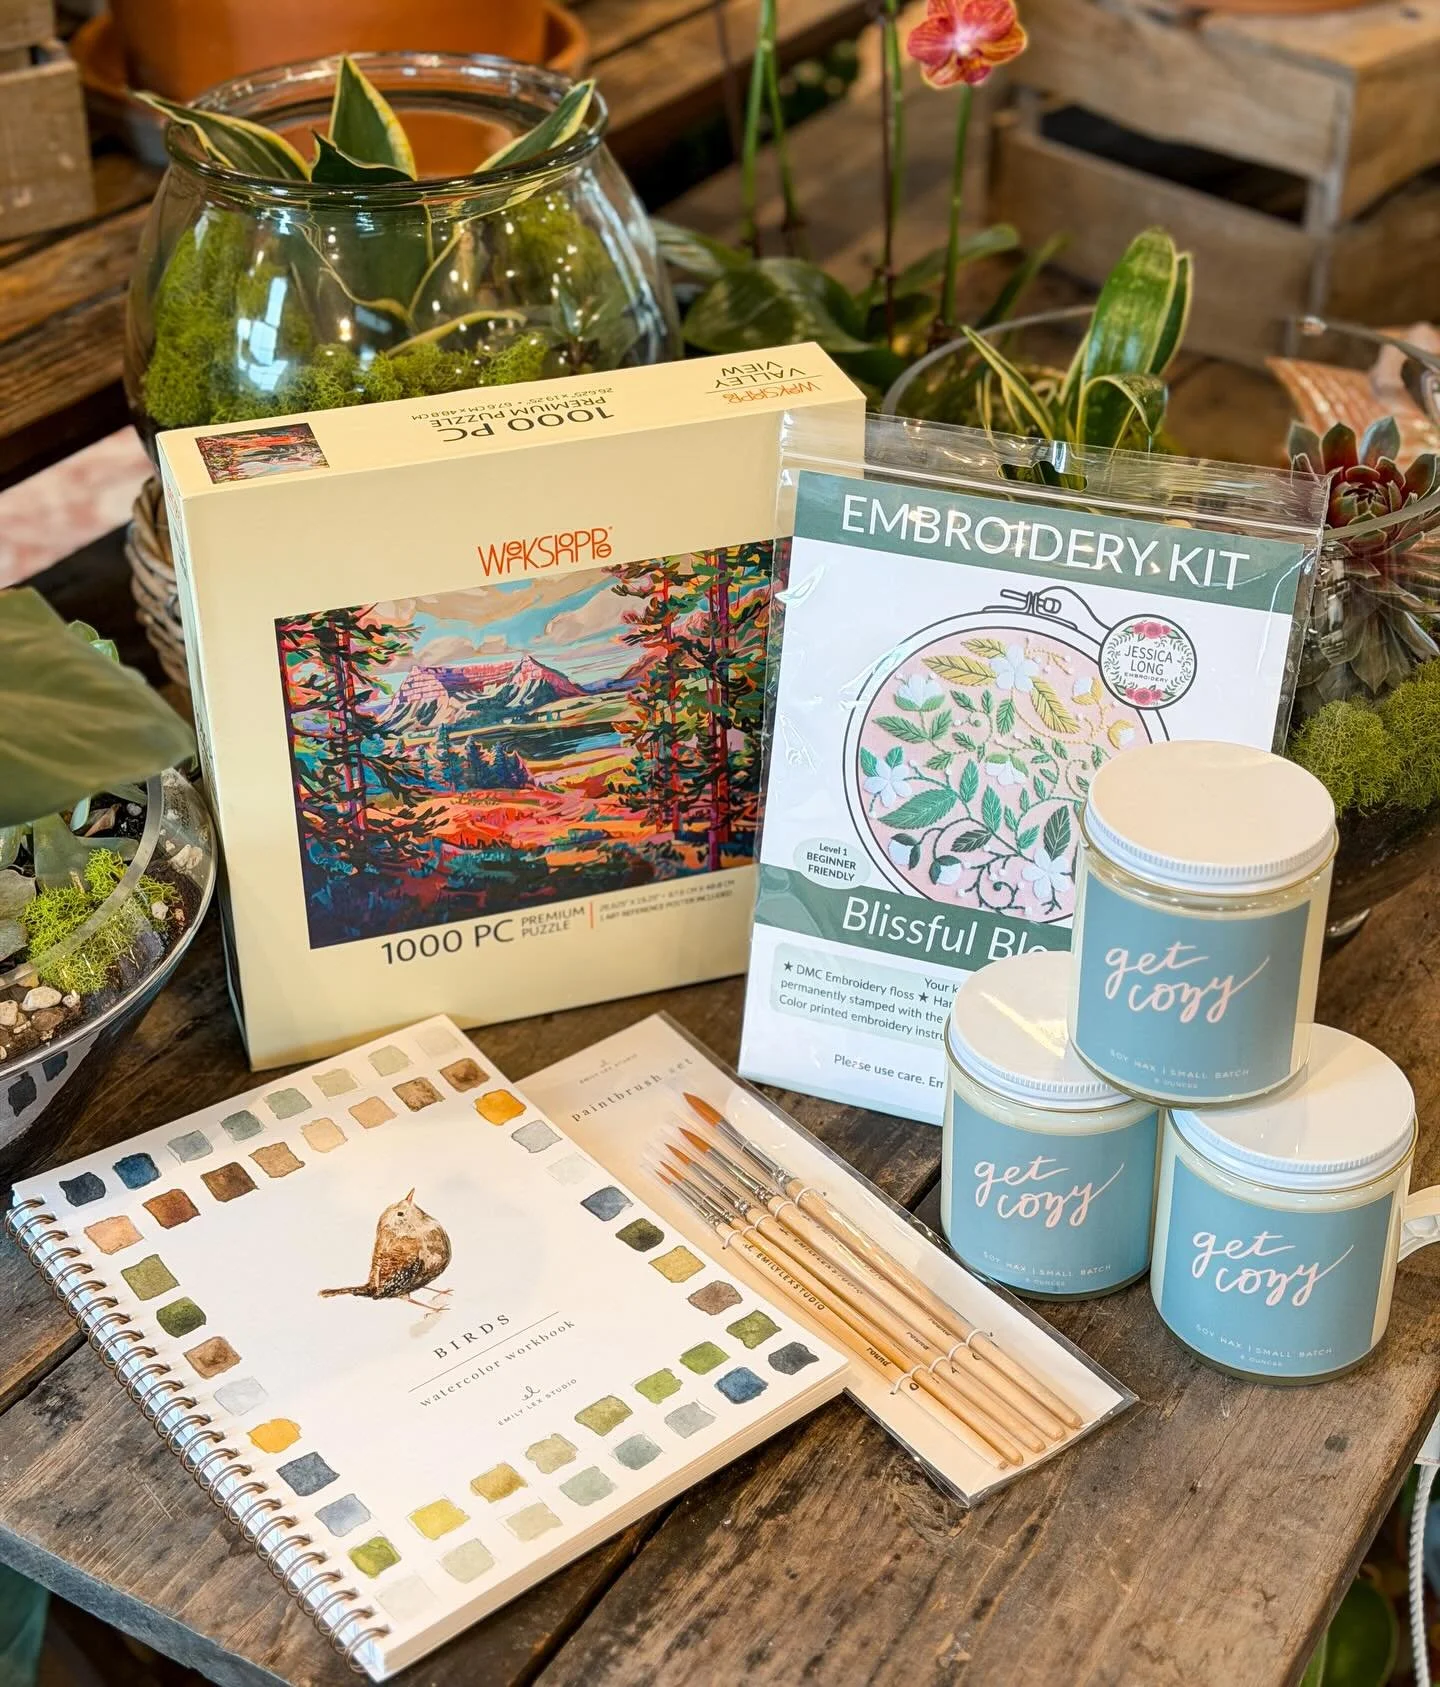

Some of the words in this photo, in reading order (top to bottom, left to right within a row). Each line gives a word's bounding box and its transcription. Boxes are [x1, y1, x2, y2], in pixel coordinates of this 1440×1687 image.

[715, 367, 806, 388] VALLEY
[721, 361, 783, 376] VIEW
[510, 396, 607, 416] PREMIUM
[411, 413, 429, 421] CM
[430, 410, 505, 428] PUZZLE
[507, 406, 615, 432] 1000
[436, 422, 495, 442] PC
[841, 493, 1159, 577] EMBROIDERY
[1168, 543, 1250, 591] KIT
[1124, 645, 1173, 664] JESSICA
[1124, 672, 1168, 683] EMBROIDERY
[1130, 659, 1164, 676] LONG
[819, 842, 841, 854] Level
[842, 848, 848, 856] 1
[806, 851, 856, 870] BEGINNER
[808, 864, 855, 882] FRIENDLY
[520, 906, 585, 927] PREMIUM
[842, 896, 978, 956] Blissful
[521, 919, 571, 938] PUZZLE
[381, 930, 463, 965] 1000
[474, 919, 514, 947] PC
[1104, 940, 1210, 1000] get
[796, 964, 824, 980] DMC
[825, 971, 887, 996] Embroidery
[889, 986, 915, 1001] floss
[924, 977, 950, 993] Your
[1128, 955, 1270, 1024] cozy
[780, 978, 847, 1004] permanently
[849, 994, 896, 1014] stamped
[898, 1003, 922, 1020] with
[925, 1010, 943, 1024] the
[779, 994, 807, 1010] Color
[809, 1001, 848, 1020] printed
[851, 1011, 912, 1036] embroidery
[834, 1053, 871, 1073] Please
[874, 1065, 894, 1078] use
[897, 1070, 925, 1086] care.
[1170, 1068, 1208, 1080] SMALL
[1215, 1069, 1249, 1080] BATCH
[571, 1073, 662, 1122] paintbrush
[974, 1155, 1070, 1208] get
[997, 1162, 1125, 1228] cozy
[1192, 1231, 1296, 1279] get
[1039, 1269, 1073, 1278] SMALL
[1080, 1264, 1112, 1276] BATCH
[1215, 1244, 1354, 1307] cozy
[433, 1314, 511, 1359] BIRDS
[866, 1347, 892, 1367] round
[1255, 1347, 1291, 1359] SMALL
[1299, 1347, 1333, 1359] BATCH
[419, 1360, 501, 1408] watercolor
[505, 1320, 576, 1361] workbook
[498, 1408, 525, 1426] EMILY
[527, 1397, 544, 1411] LEX
[545, 1378, 577, 1399] STUDIO
